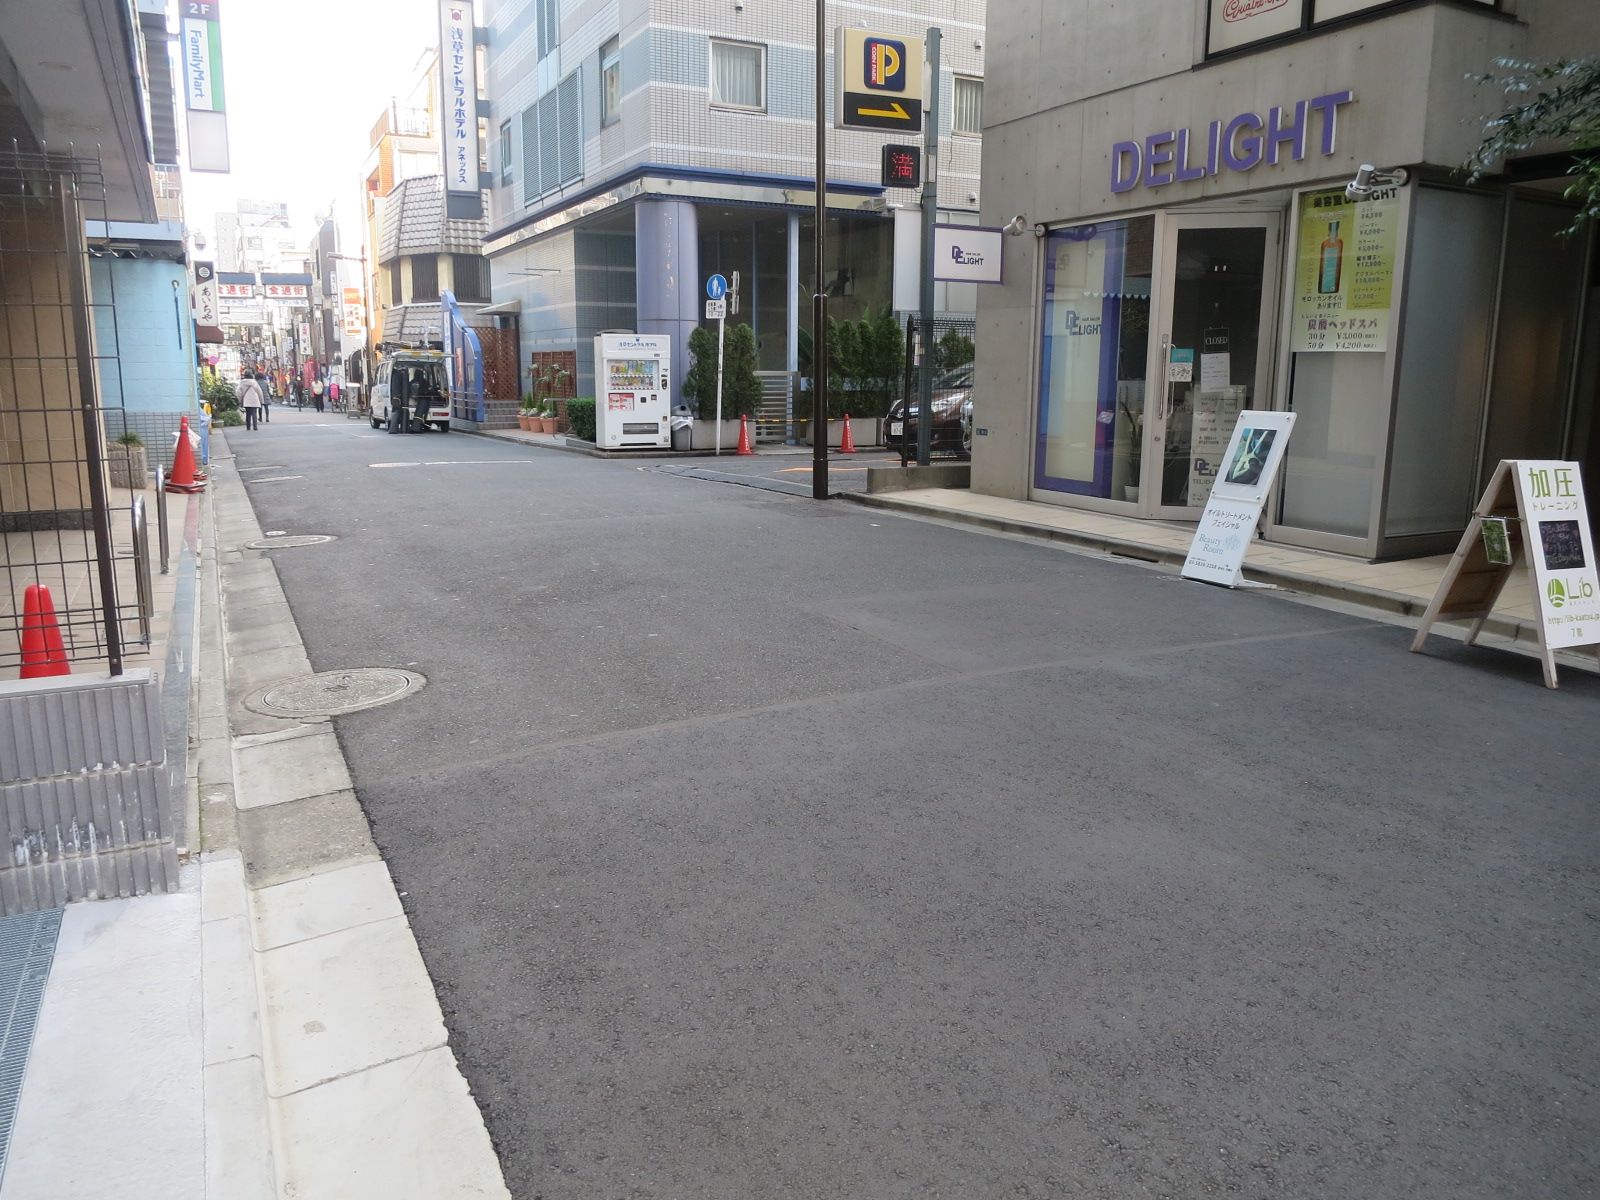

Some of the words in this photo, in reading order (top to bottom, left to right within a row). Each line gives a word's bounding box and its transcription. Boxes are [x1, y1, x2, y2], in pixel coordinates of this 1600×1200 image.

[189, 2, 210, 15] 2F
[189, 29, 206, 99] FamilyMart
[450, 26, 467, 140] 浅草セントラルホテル
[1110, 90, 1353, 194] DELIGHT
[457, 146, 467, 184] アネックス
[891, 152, 914, 179] 満
[951, 245, 985, 266] DELIGHT
[268, 285, 305, 296] 食通街
[1308, 318, 1378, 332] 炭酸ヘッドスパ
[1205, 336, 1228, 345] CLOSED
[1528, 467, 1577, 498] 加圧
[1532, 501, 1579, 512] トレーニング
[1210, 519, 1241, 530] フェイシャル
[1199, 533, 1222, 546] Beauty
[1202, 543, 1224, 555] Room
